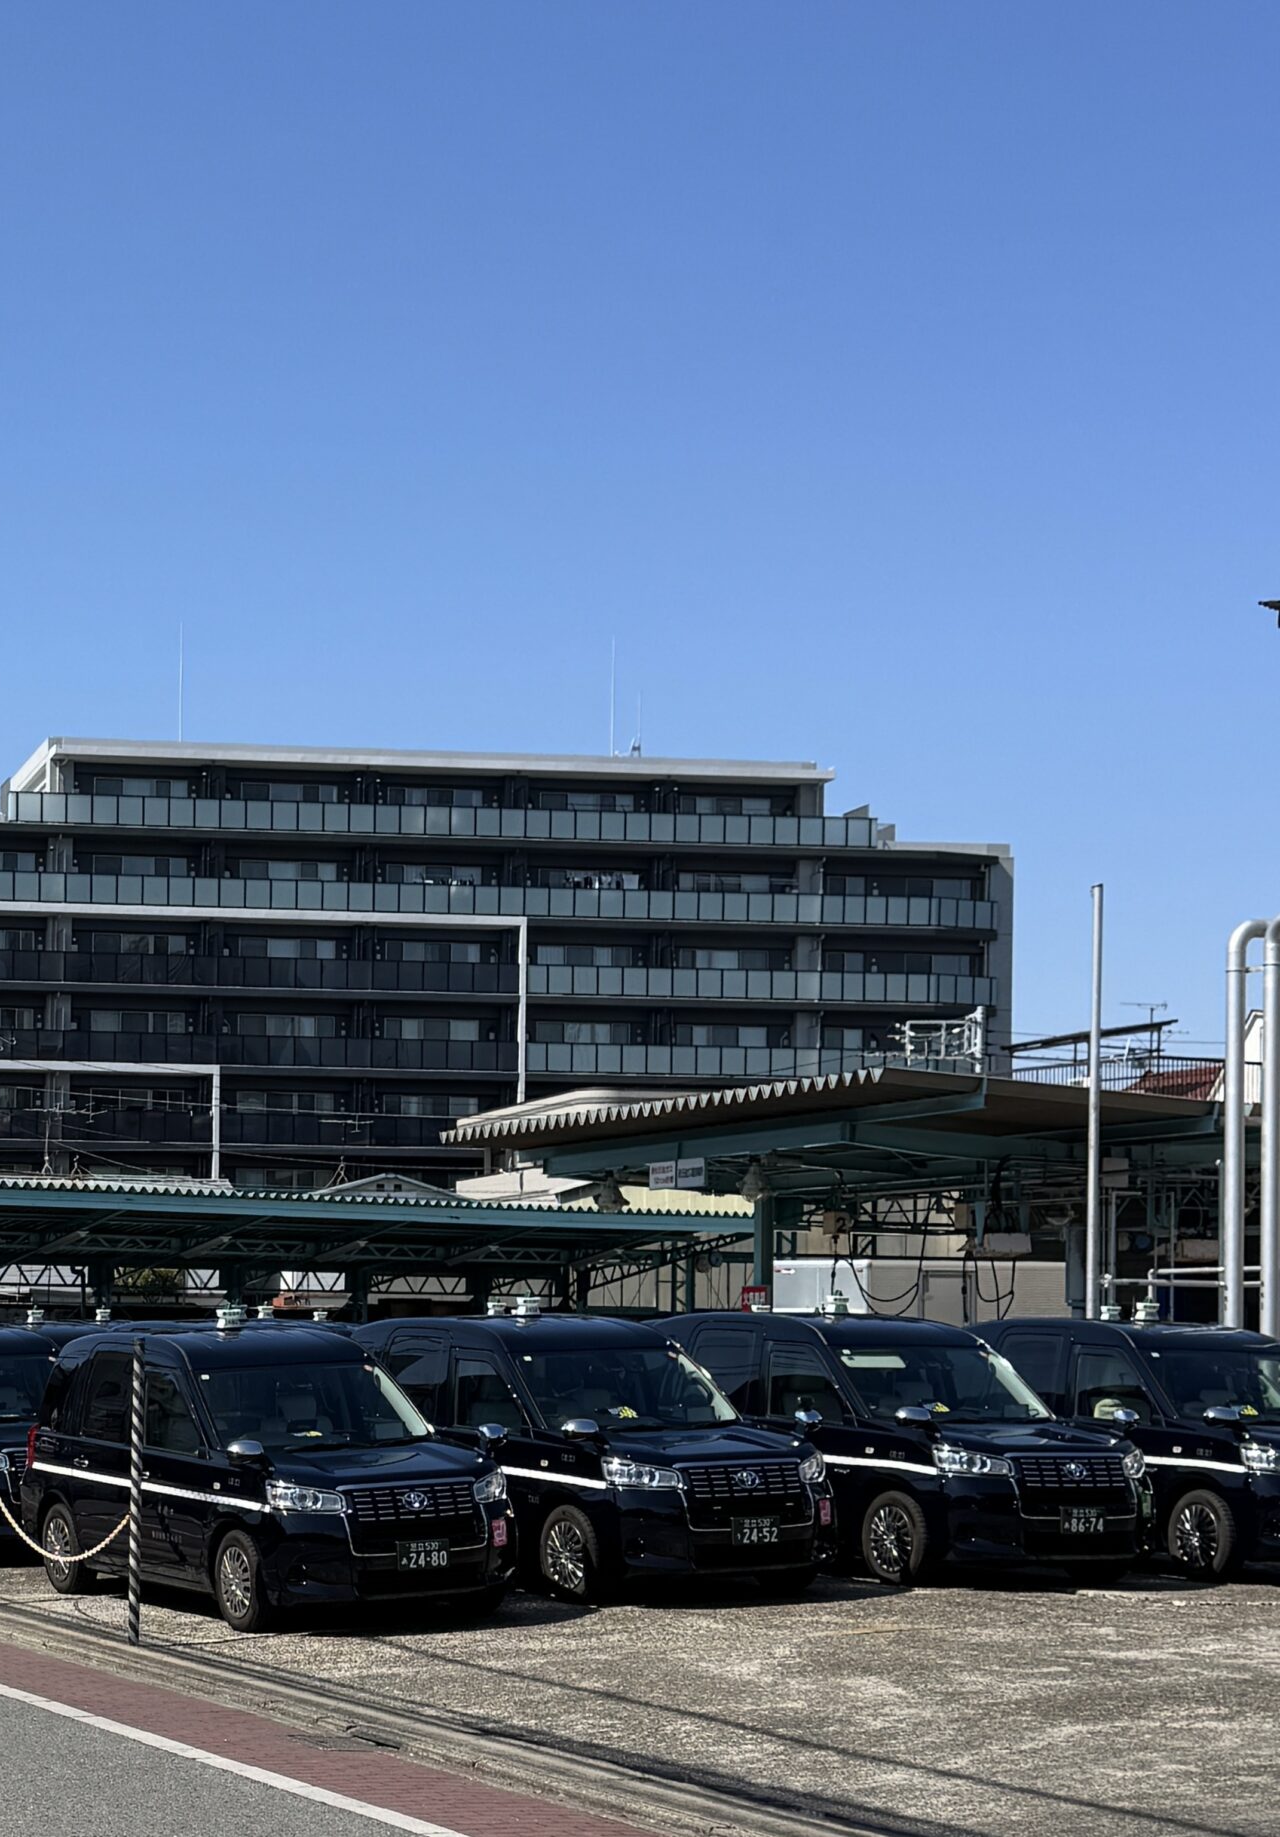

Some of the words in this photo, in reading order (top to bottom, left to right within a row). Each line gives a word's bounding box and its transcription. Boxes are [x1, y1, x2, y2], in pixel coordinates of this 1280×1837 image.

[836, 1217, 847, 1233] 2
[1071, 1518, 1104, 1532] 86-74
[743, 1527, 778, 1543] 24-52
[409, 1551, 447, 1568] 24-80
